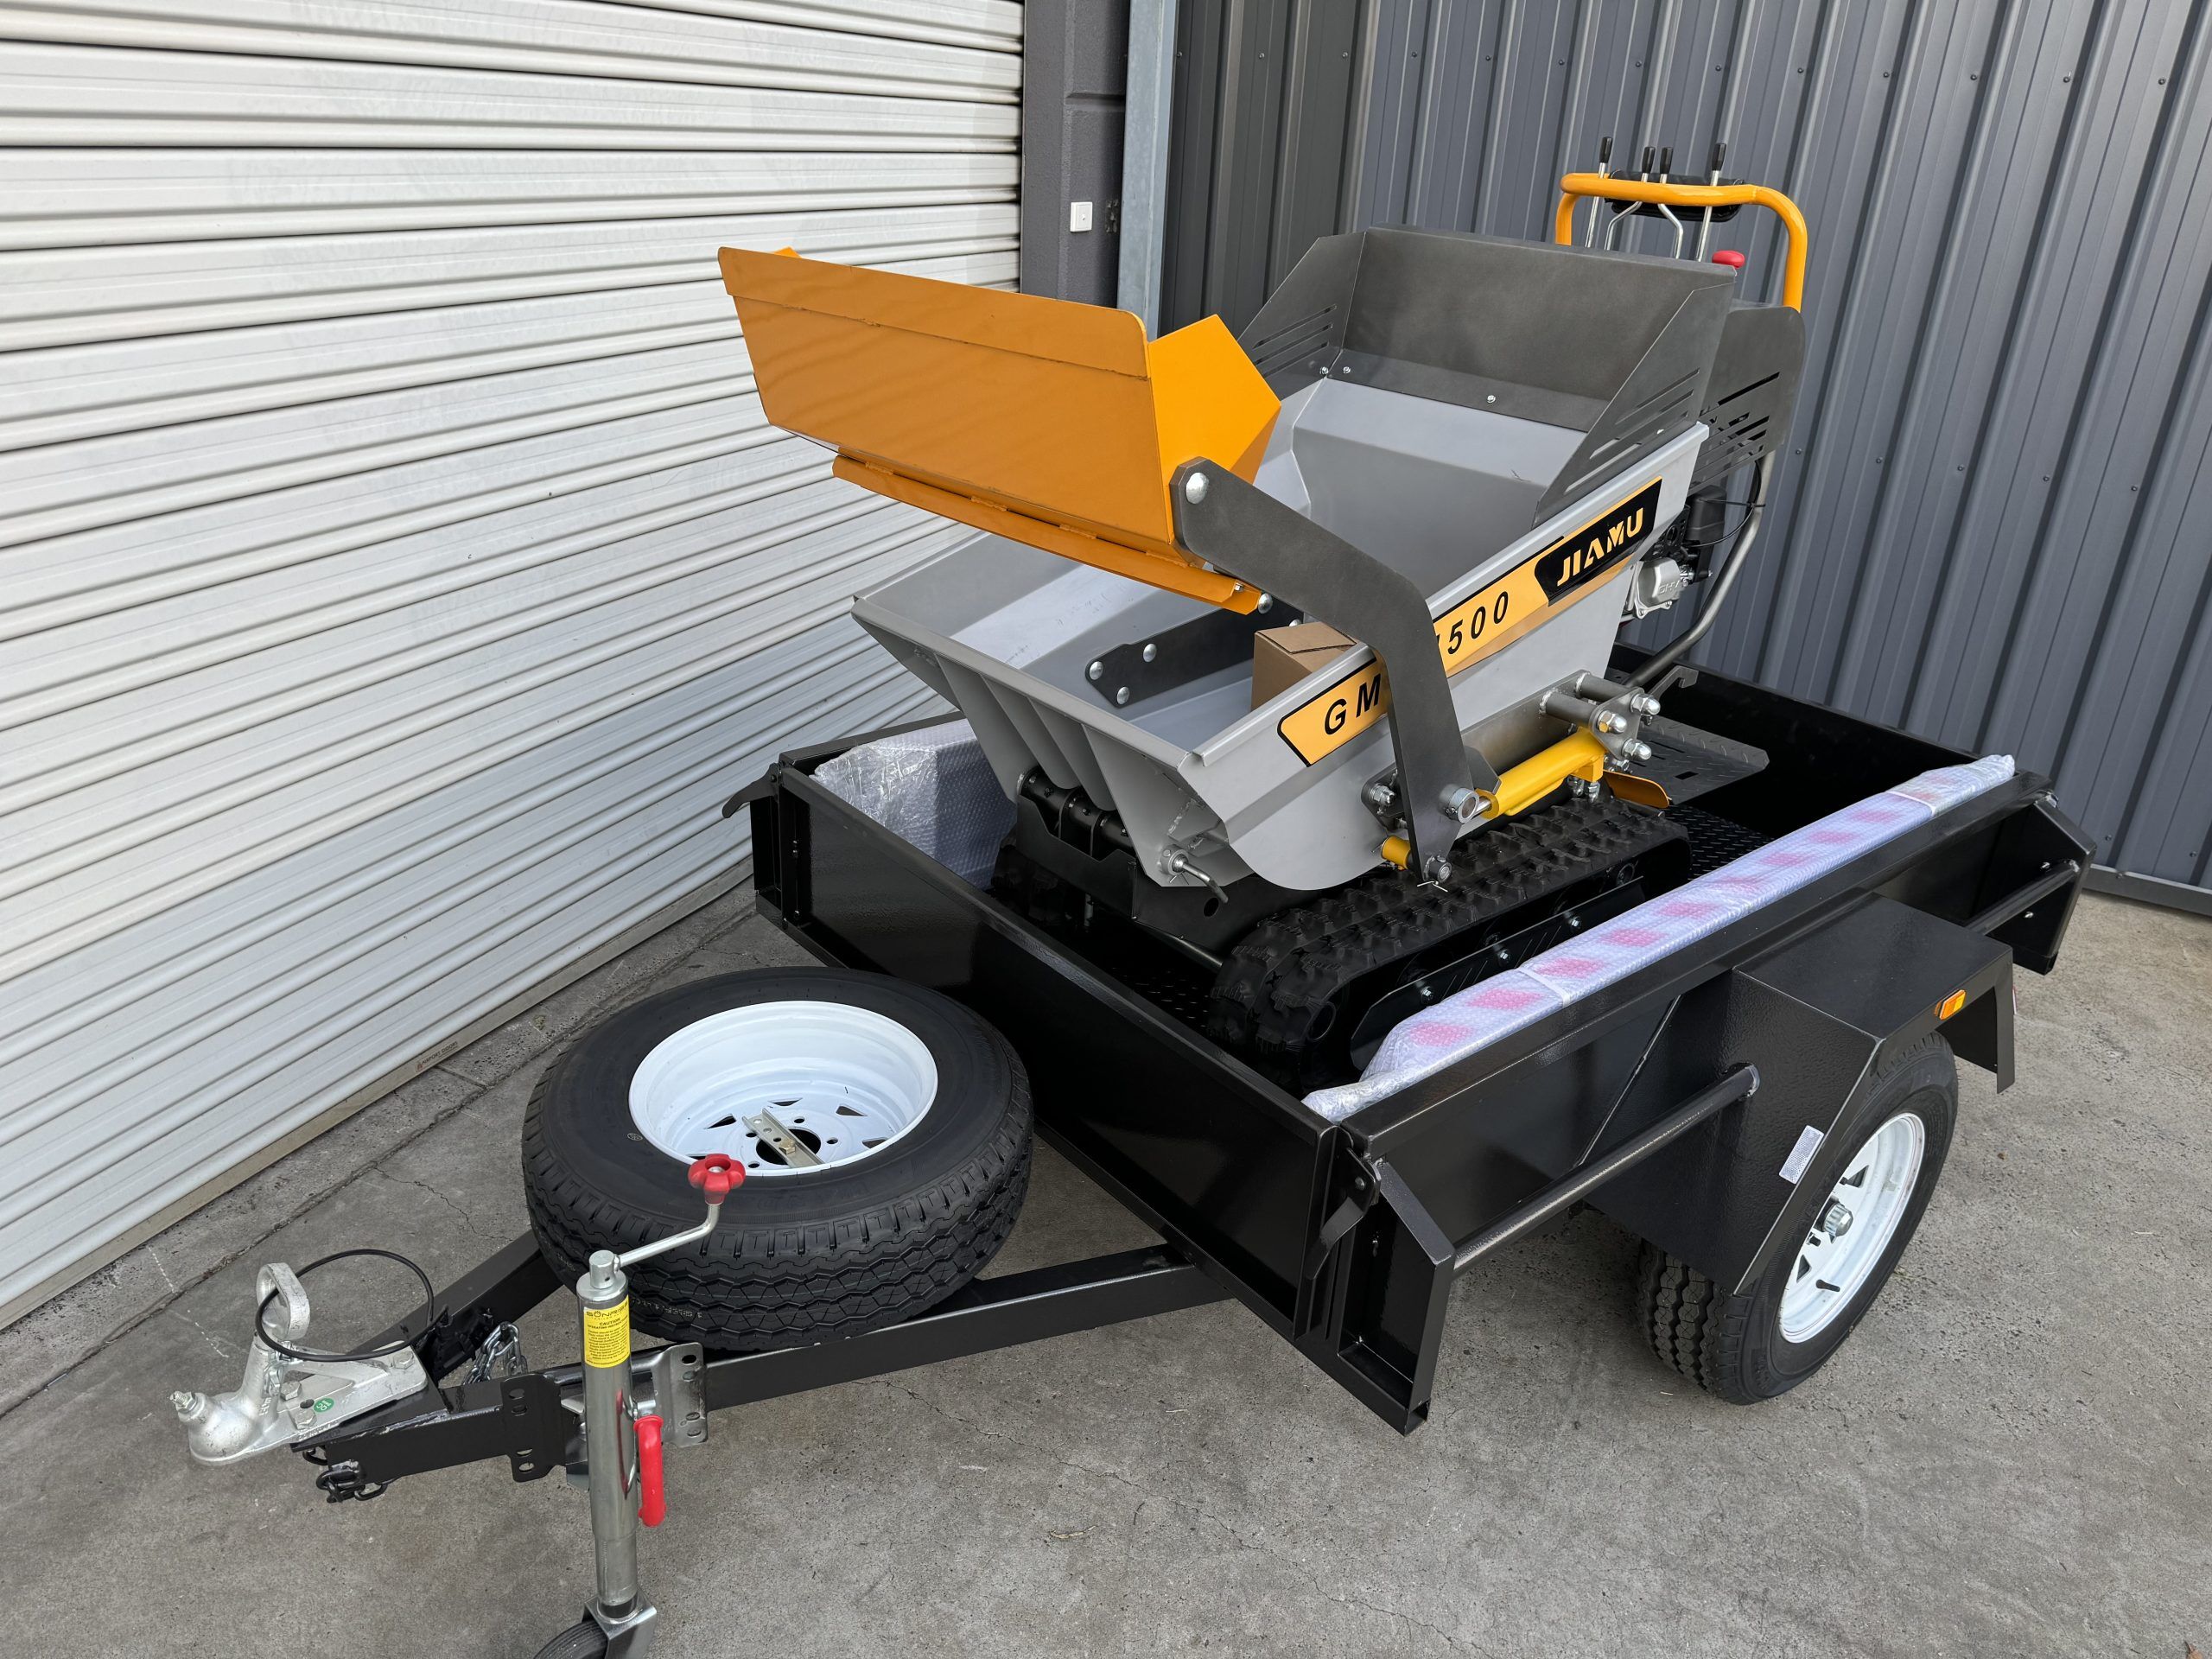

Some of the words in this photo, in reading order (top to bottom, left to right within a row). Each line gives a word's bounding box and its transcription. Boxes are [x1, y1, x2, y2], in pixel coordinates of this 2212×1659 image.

[1557, 507, 1643, 587] JIAMU
[1436, 592, 1509, 654] 500
[600, 1318, 620, 1326] CAUTION
